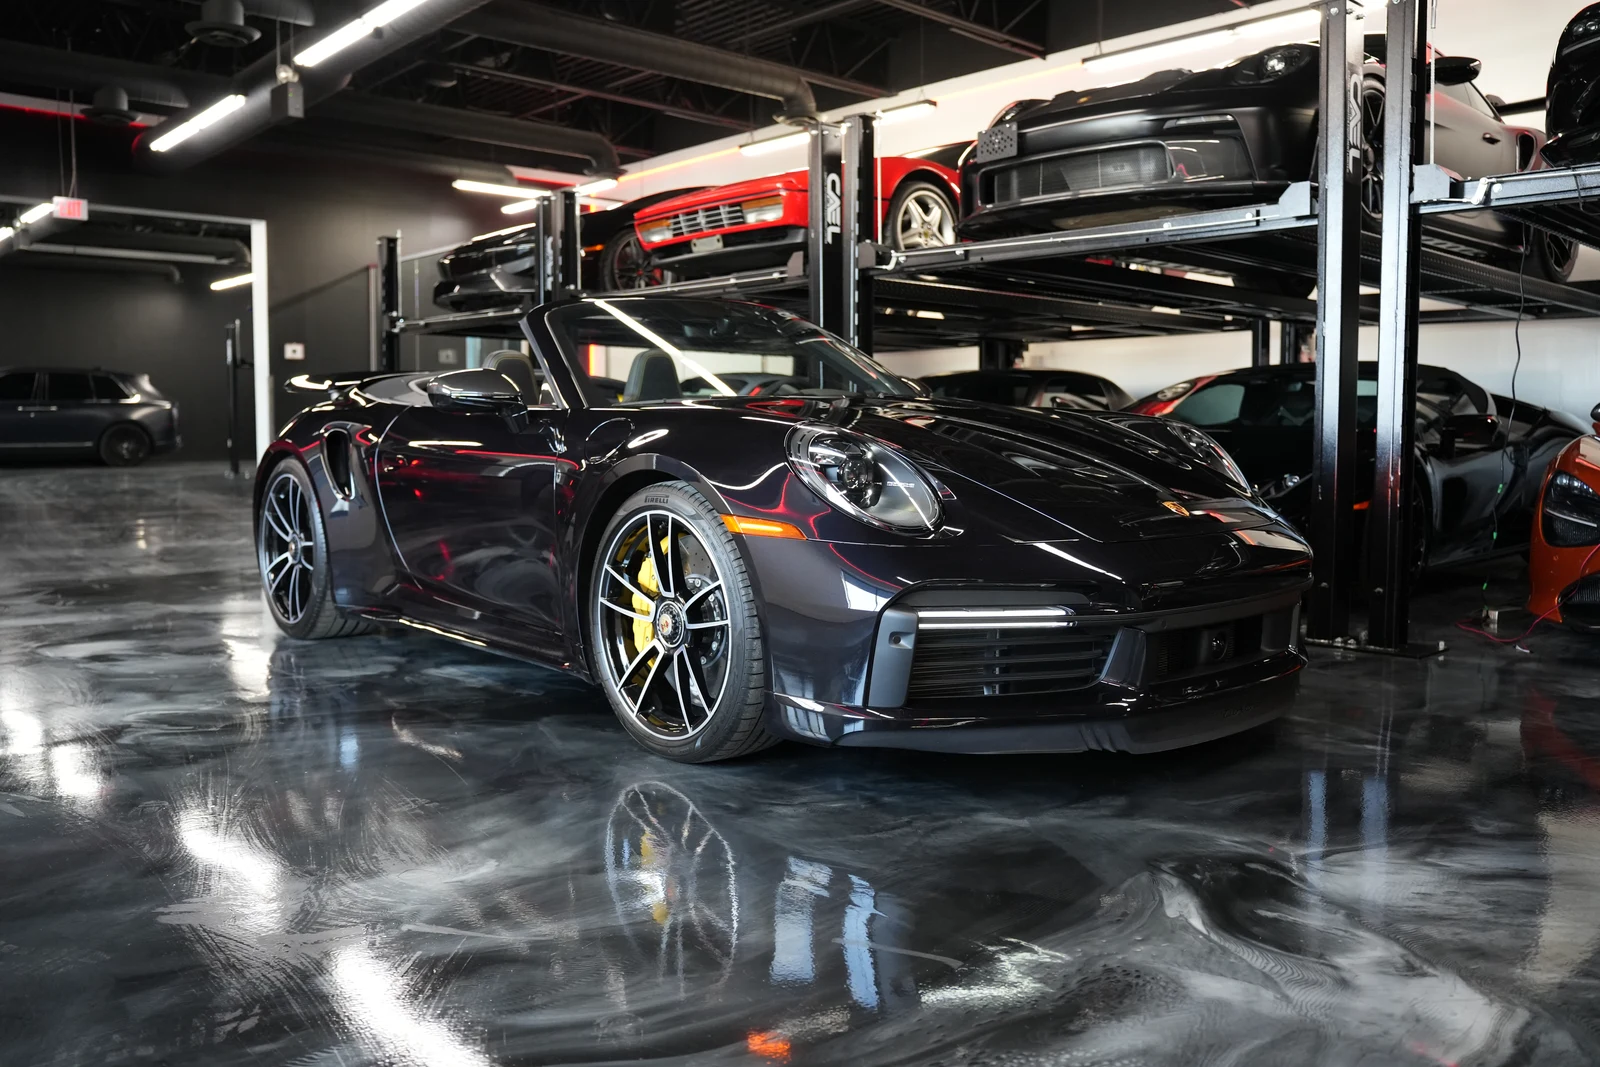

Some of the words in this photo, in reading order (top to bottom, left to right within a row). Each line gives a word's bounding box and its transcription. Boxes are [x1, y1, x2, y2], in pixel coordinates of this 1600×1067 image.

[1349, 73, 1361, 174] CAEL
[827, 172, 841, 245] CAEL
[644, 494, 670, 504] PIRELLI
